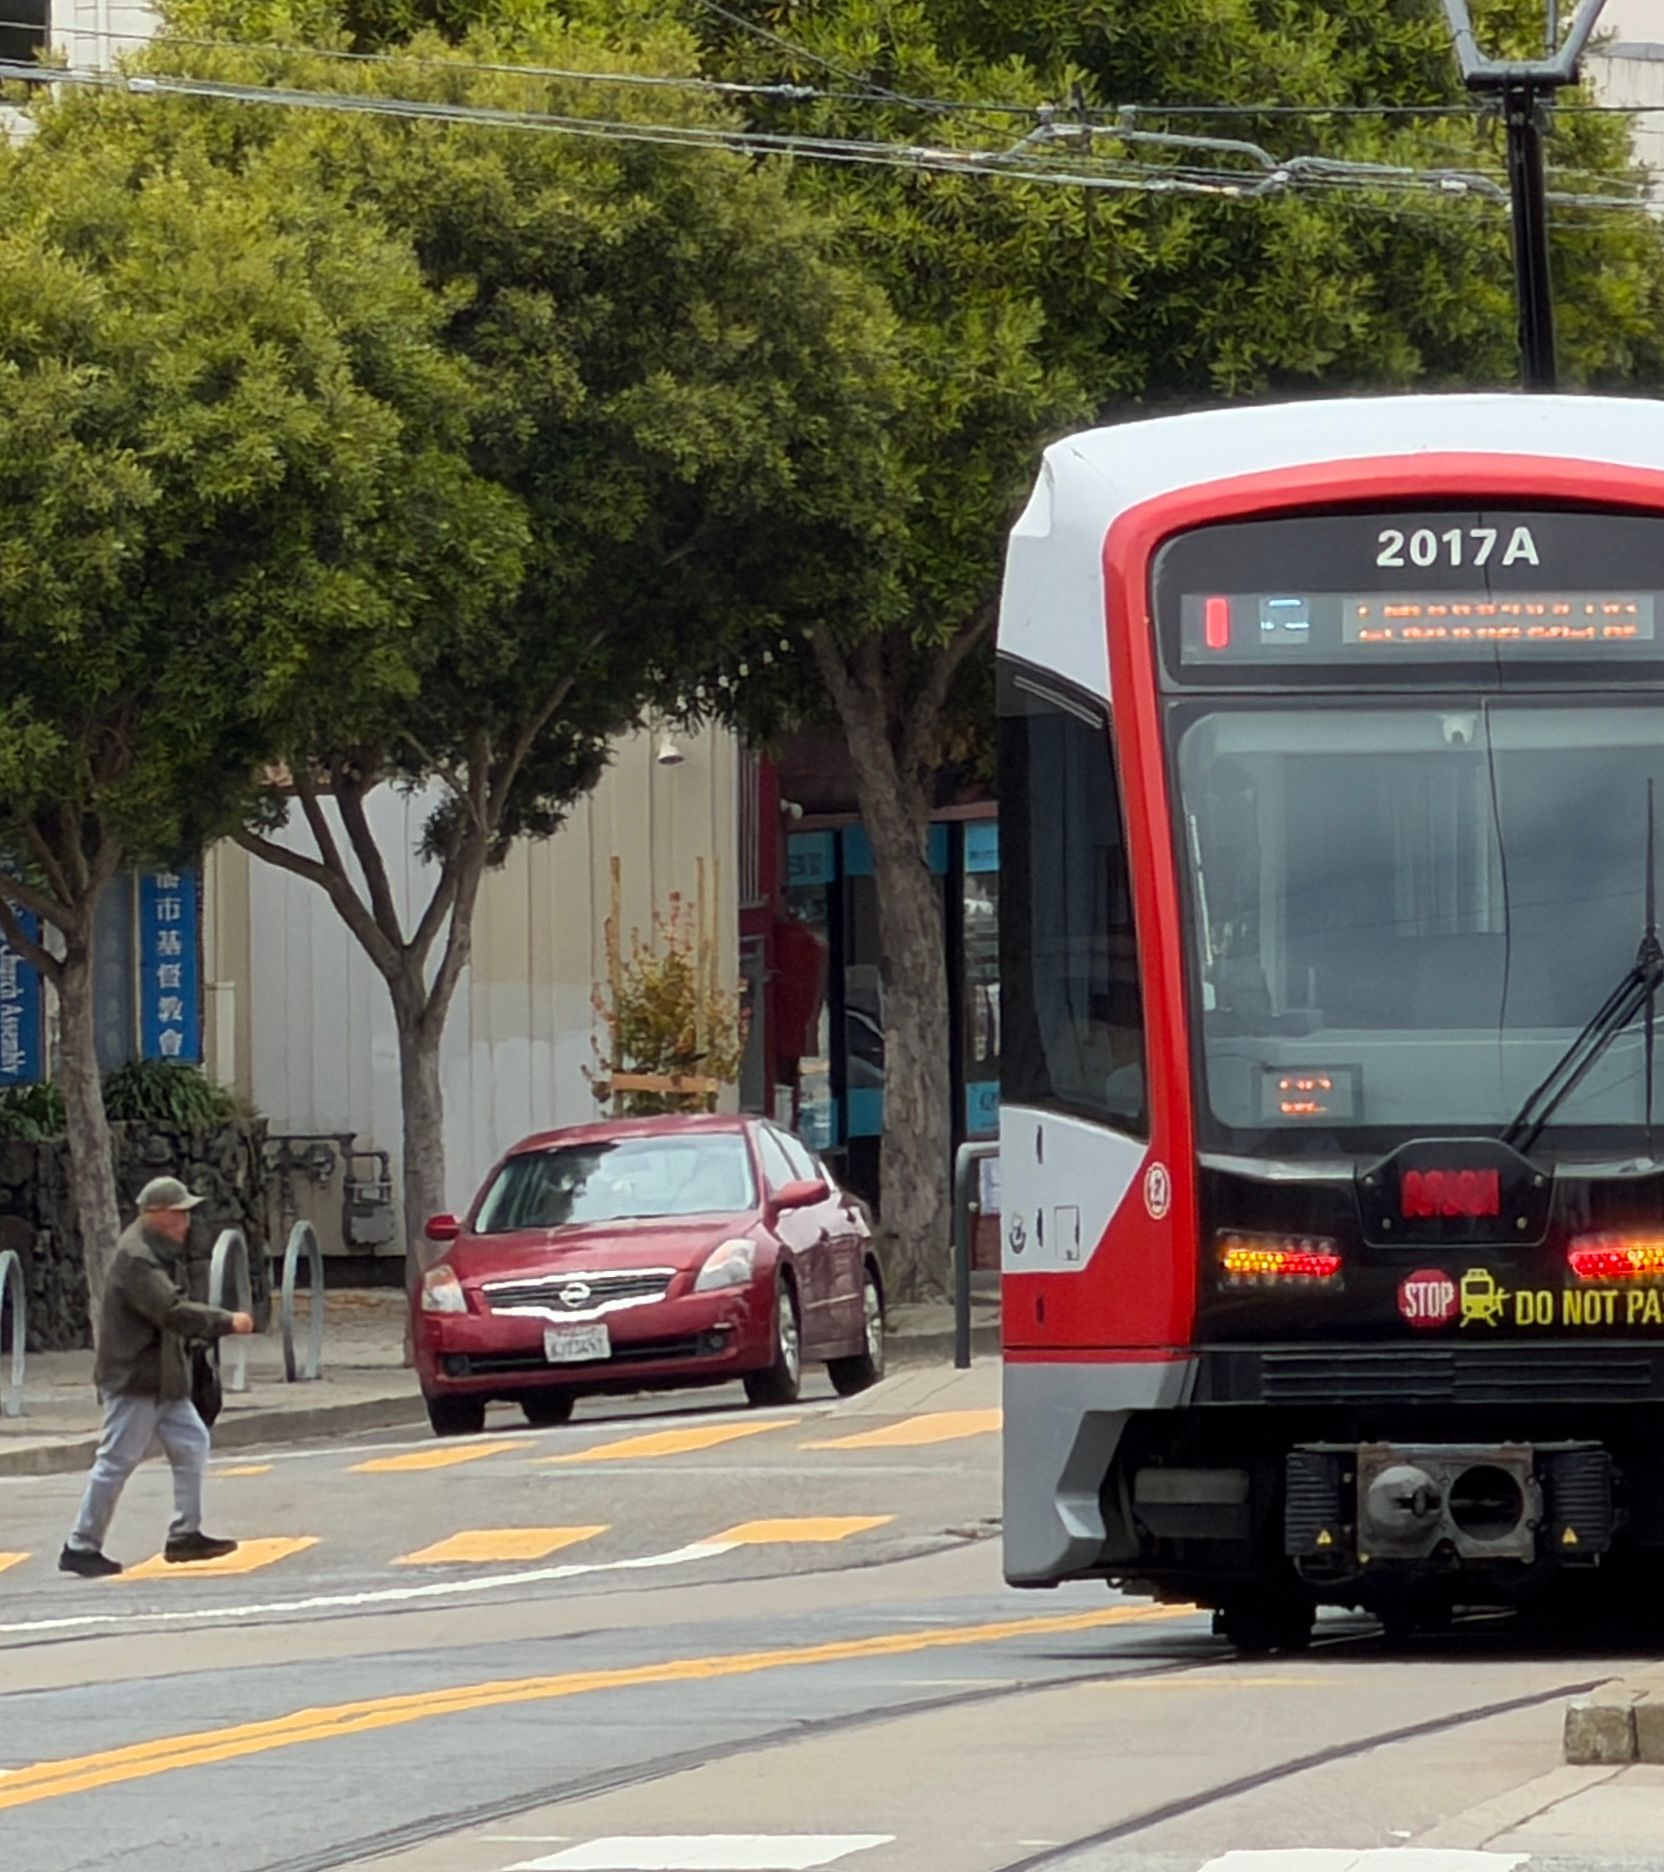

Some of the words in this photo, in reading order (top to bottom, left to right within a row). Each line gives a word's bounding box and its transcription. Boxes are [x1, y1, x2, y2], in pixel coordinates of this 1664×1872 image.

[1376, 527, 1540, 568] 2017A
[1404, 1282, 1454, 1318] STOP
[1515, 1290, 1553, 1326] DO
[1562, 1289, 1619, 1325] NOT
